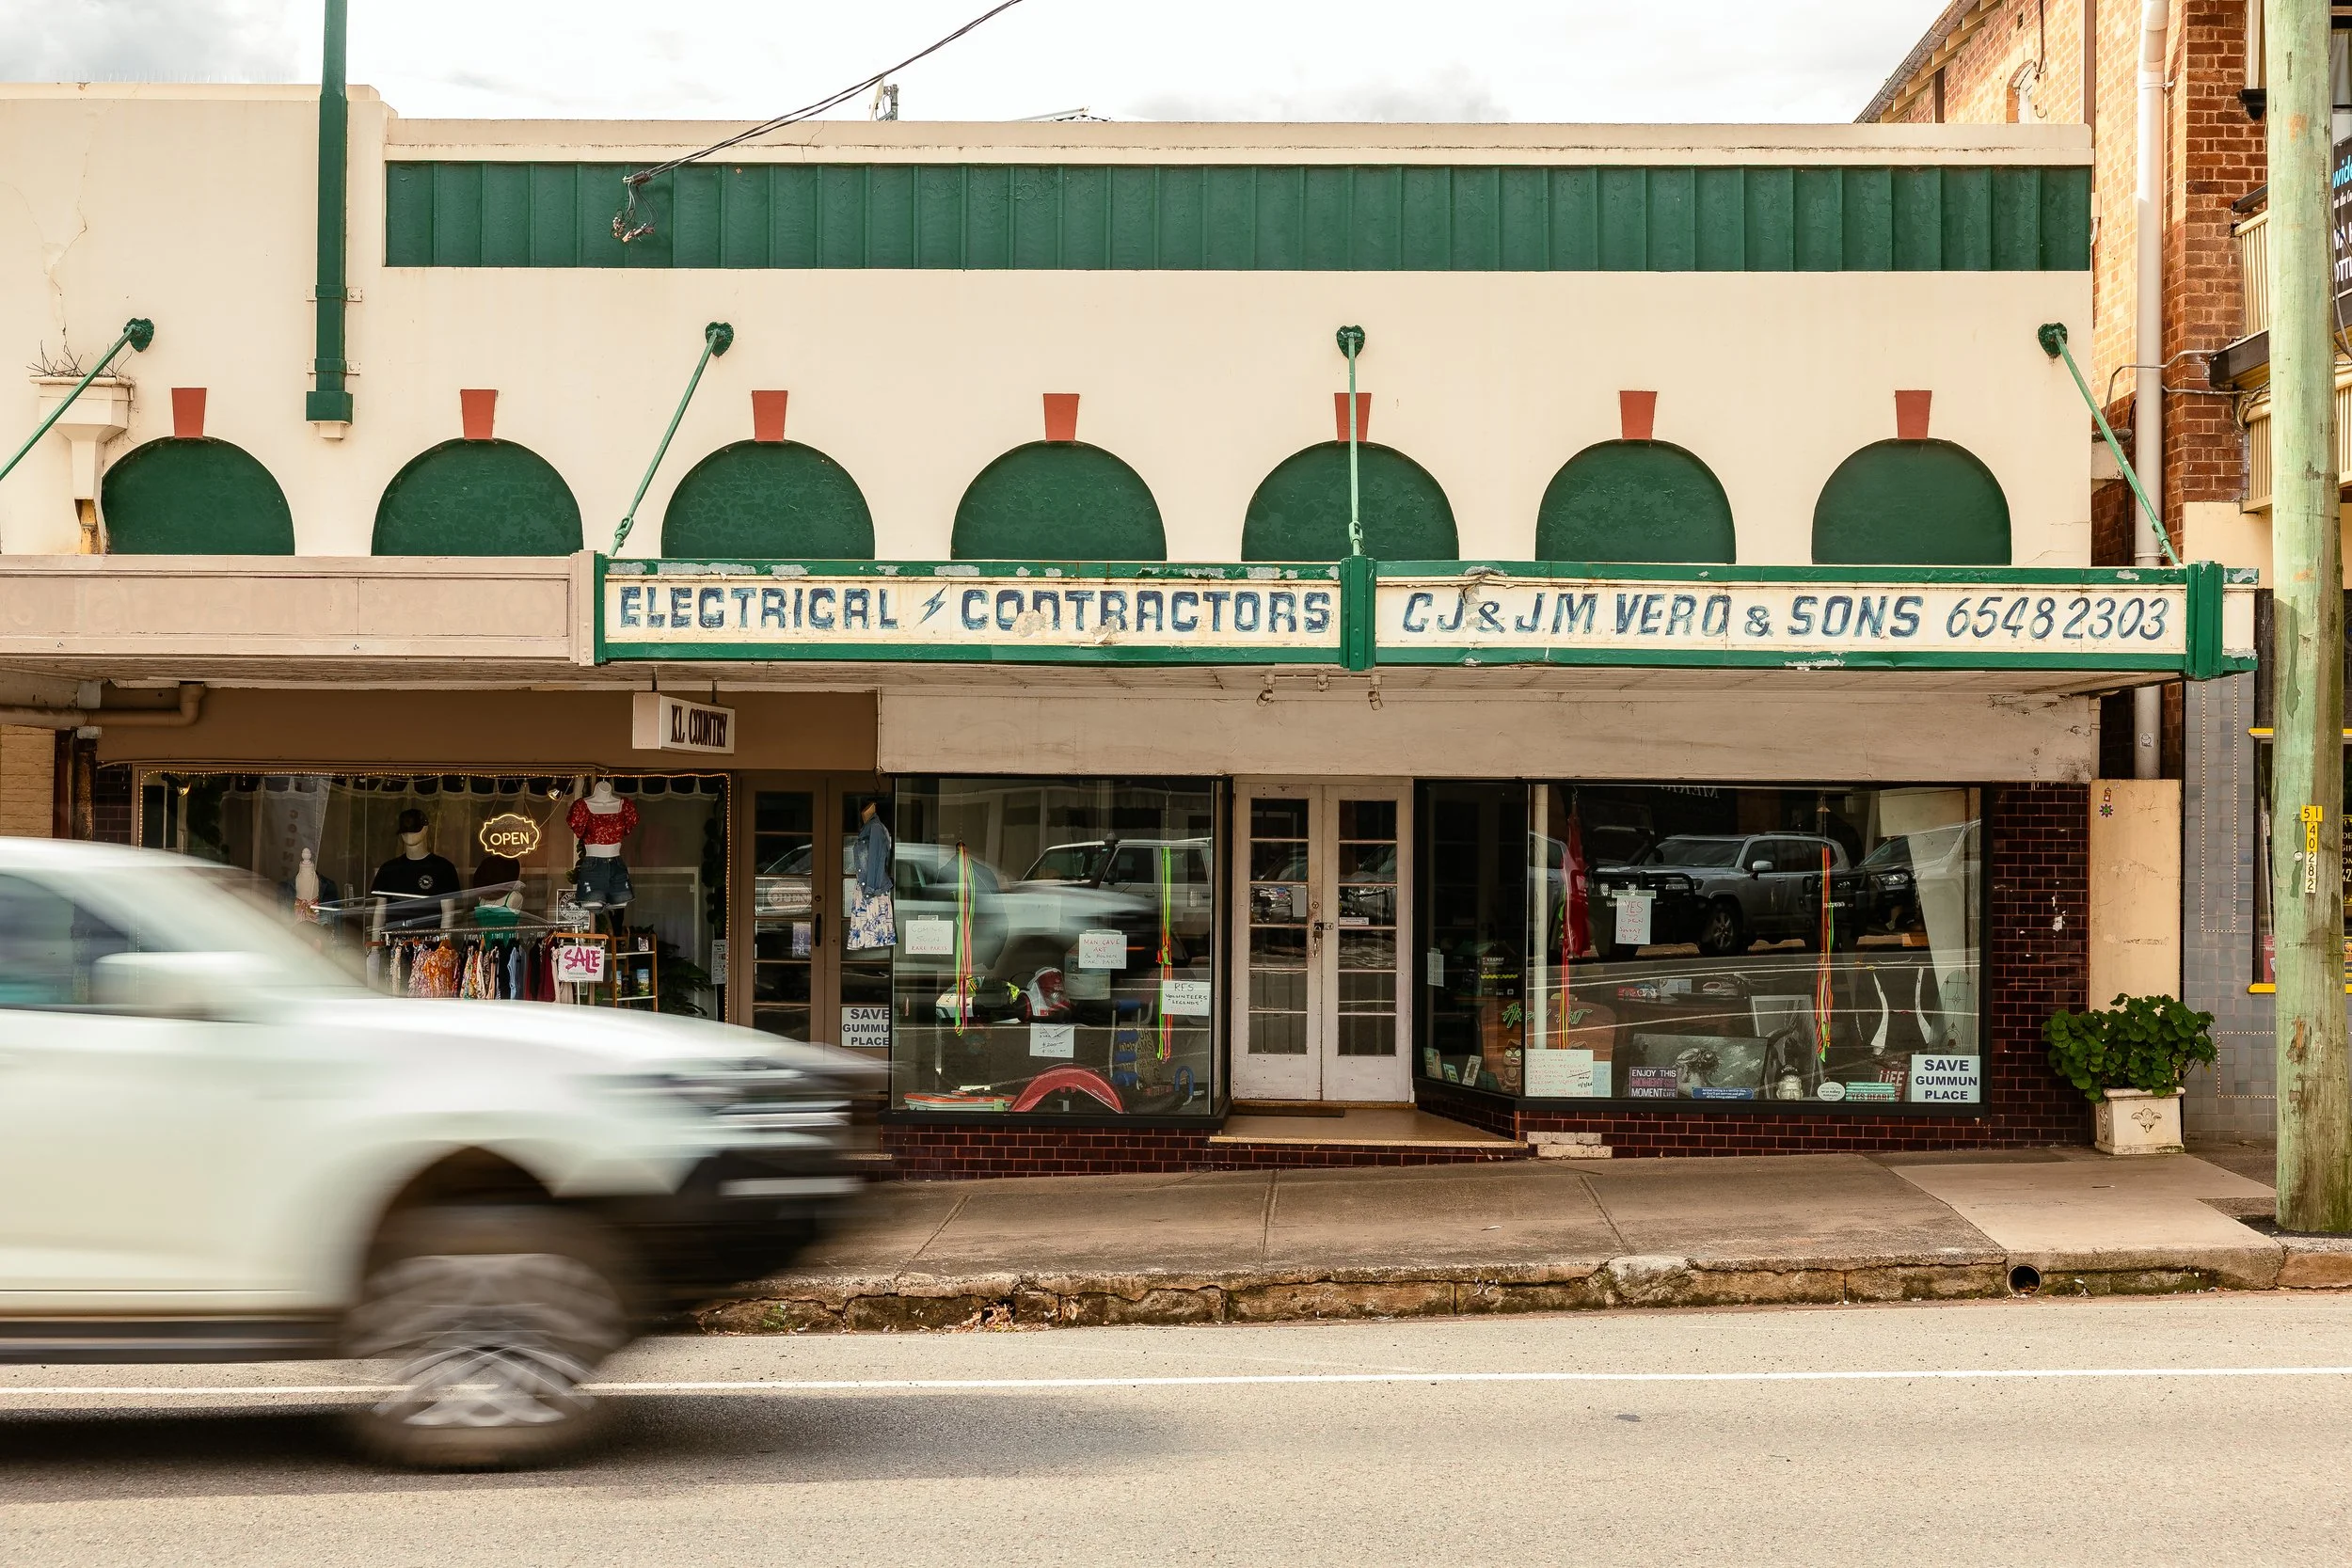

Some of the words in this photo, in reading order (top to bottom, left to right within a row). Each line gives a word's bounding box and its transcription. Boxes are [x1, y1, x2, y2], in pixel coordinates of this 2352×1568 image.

[619, 586, 898, 630] ELECTRICAL
[961, 588, 1332, 634] CONTRACTORS
[1476, 600, 1506, 634] &
[1614, 593, 1733, 638] VERO
[1743, 605, 1773, 638] &
[1788, 594, 1925, 639] SONS
[671, 705, 685, 743] KL
[689, 707, 728, 748] COUNTRY
[2304, 809, 2319, 819] 51
[490, 832, 530, 846] OPEN
[1624, 900, 1644, 913] YES
[564, 947, 601, 974] SALE
[1174, 982, 1195, 992] RFS
[850, 1008, 889, 1020] SAVE
[843, 1023, 889, 1033] GUMMU
[851, 1037, 889, 1046] PLACE
[1924, 1059, 1970, 1072] SAVE
[1660, 1069, 1677, 1078] THIS
[1915, 1075, 1978, 1085] GUMMUN
[1631, 1087, 1663, 1098] MOMENT
[1924, 1089, 1969, 1101] PLACE
